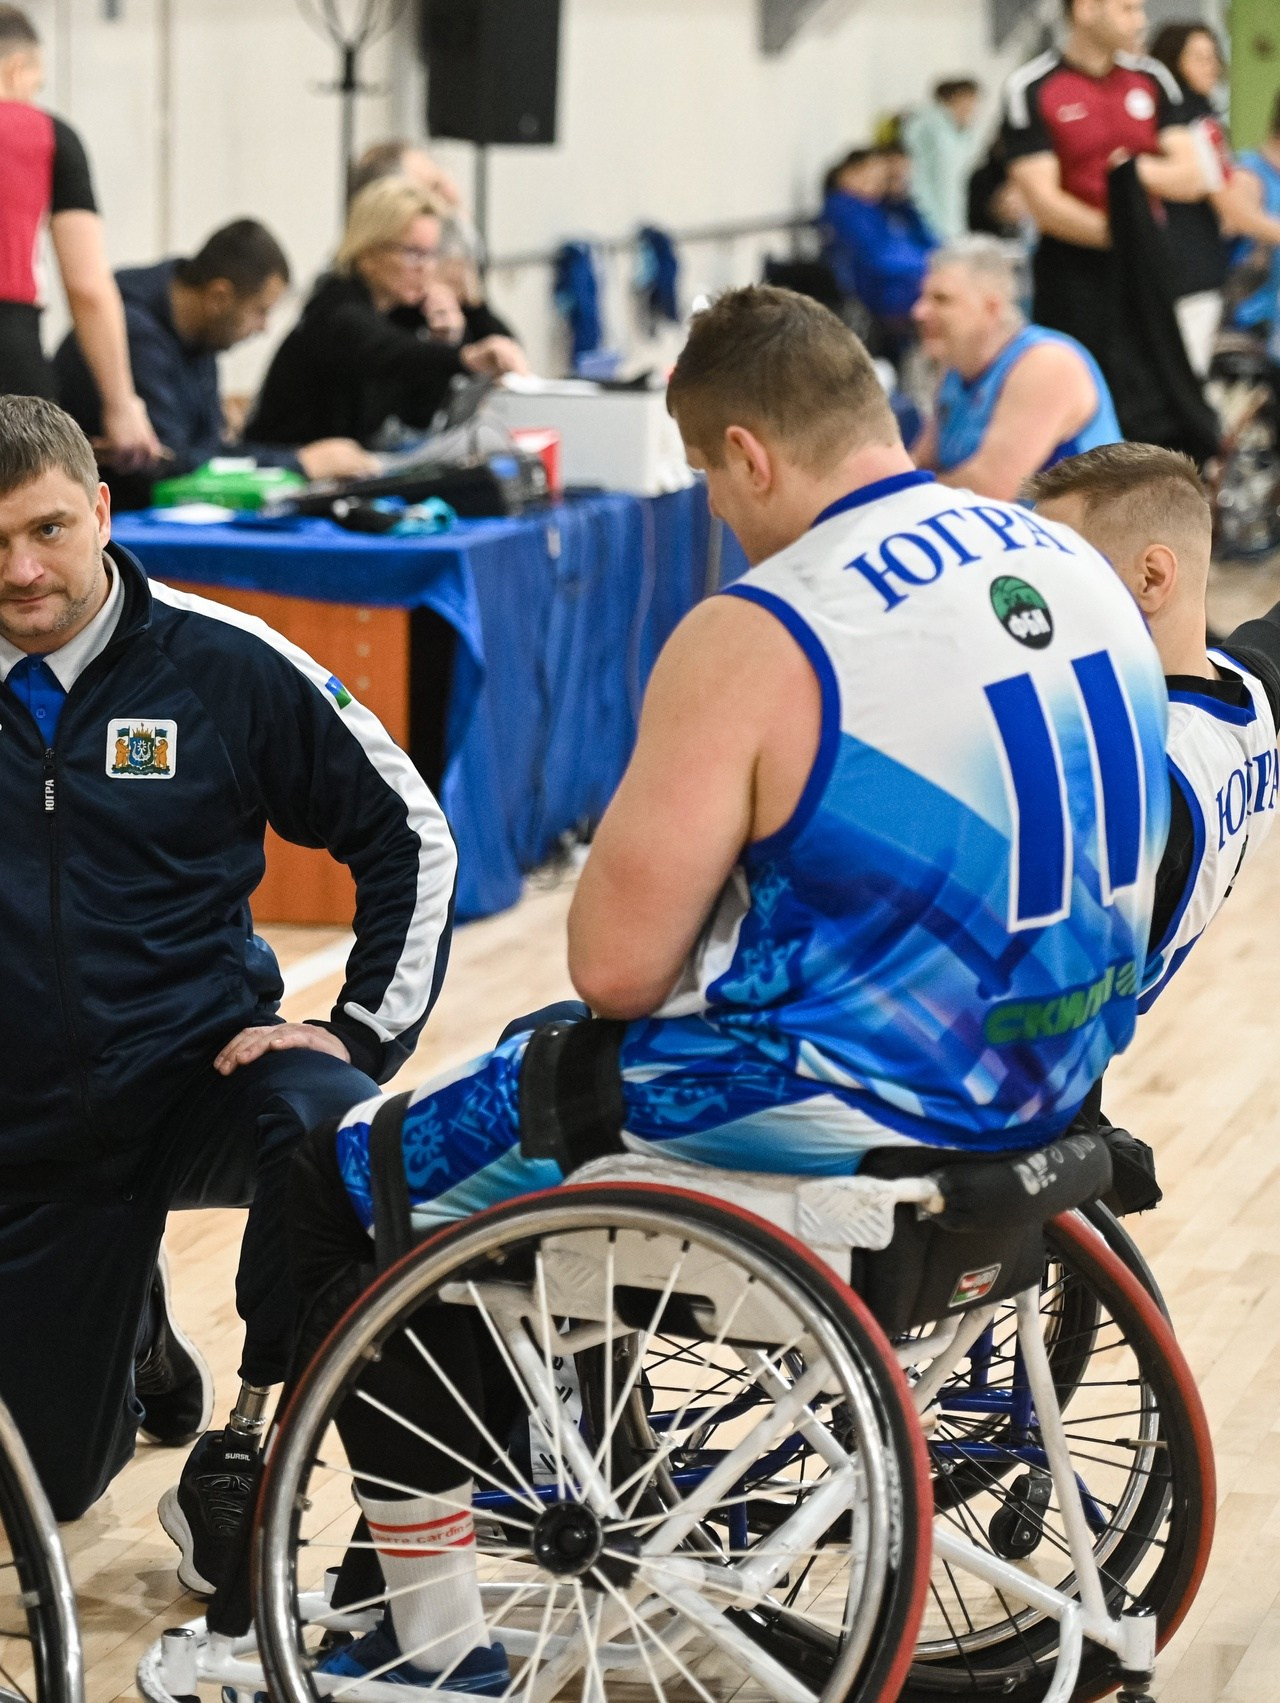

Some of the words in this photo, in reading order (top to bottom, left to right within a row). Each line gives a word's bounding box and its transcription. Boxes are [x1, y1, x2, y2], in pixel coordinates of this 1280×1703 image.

[843, 506, 1076, 613] ЮГРА
[45, 779, 55, 811] ЮГРА
[983, 649, 1143, 933] 11
[224, 1452, 251, 1461] SURSIL
[416, 1524, 464, 1544] cardin
